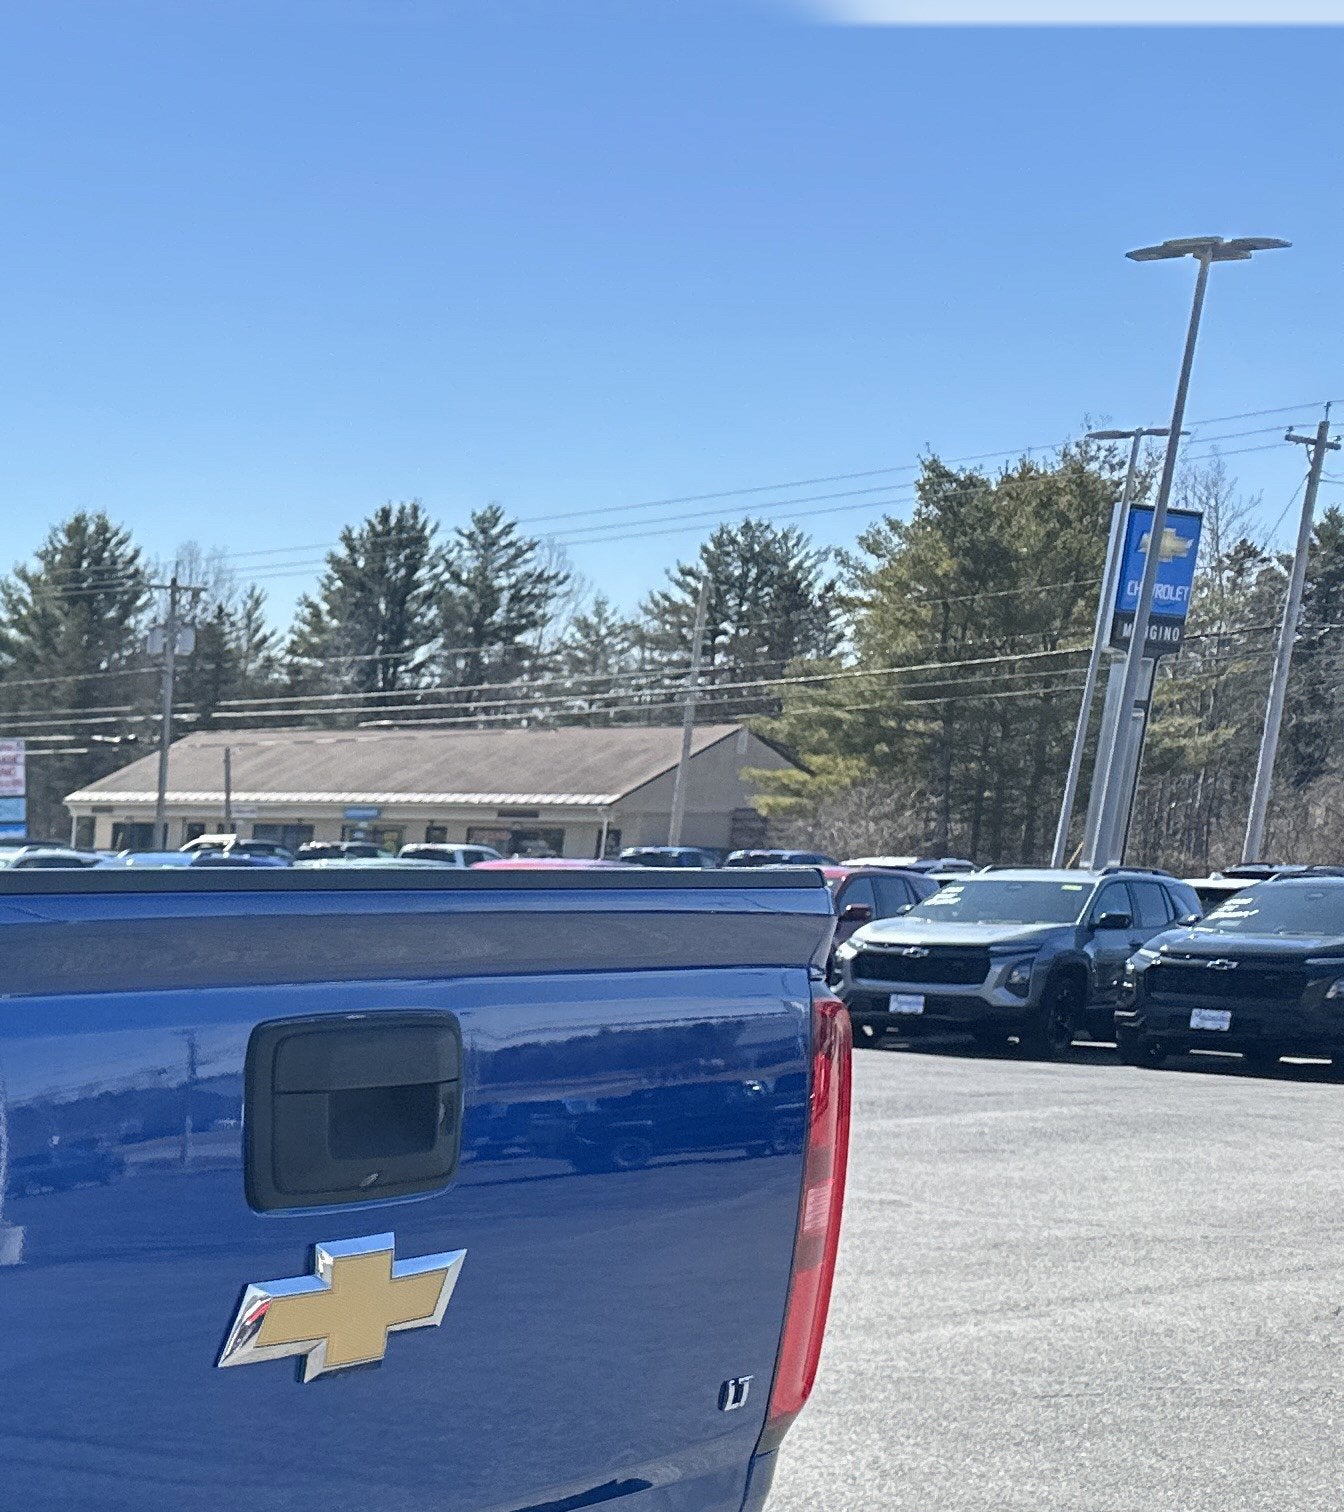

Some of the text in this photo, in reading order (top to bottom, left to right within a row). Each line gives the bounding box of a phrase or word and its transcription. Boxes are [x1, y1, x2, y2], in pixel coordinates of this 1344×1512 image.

[1127, 580, 1189, 602] CHROLET
[1122, 622, 1180, 642] MGINO
[722, 1375, 754, 1412] LT
